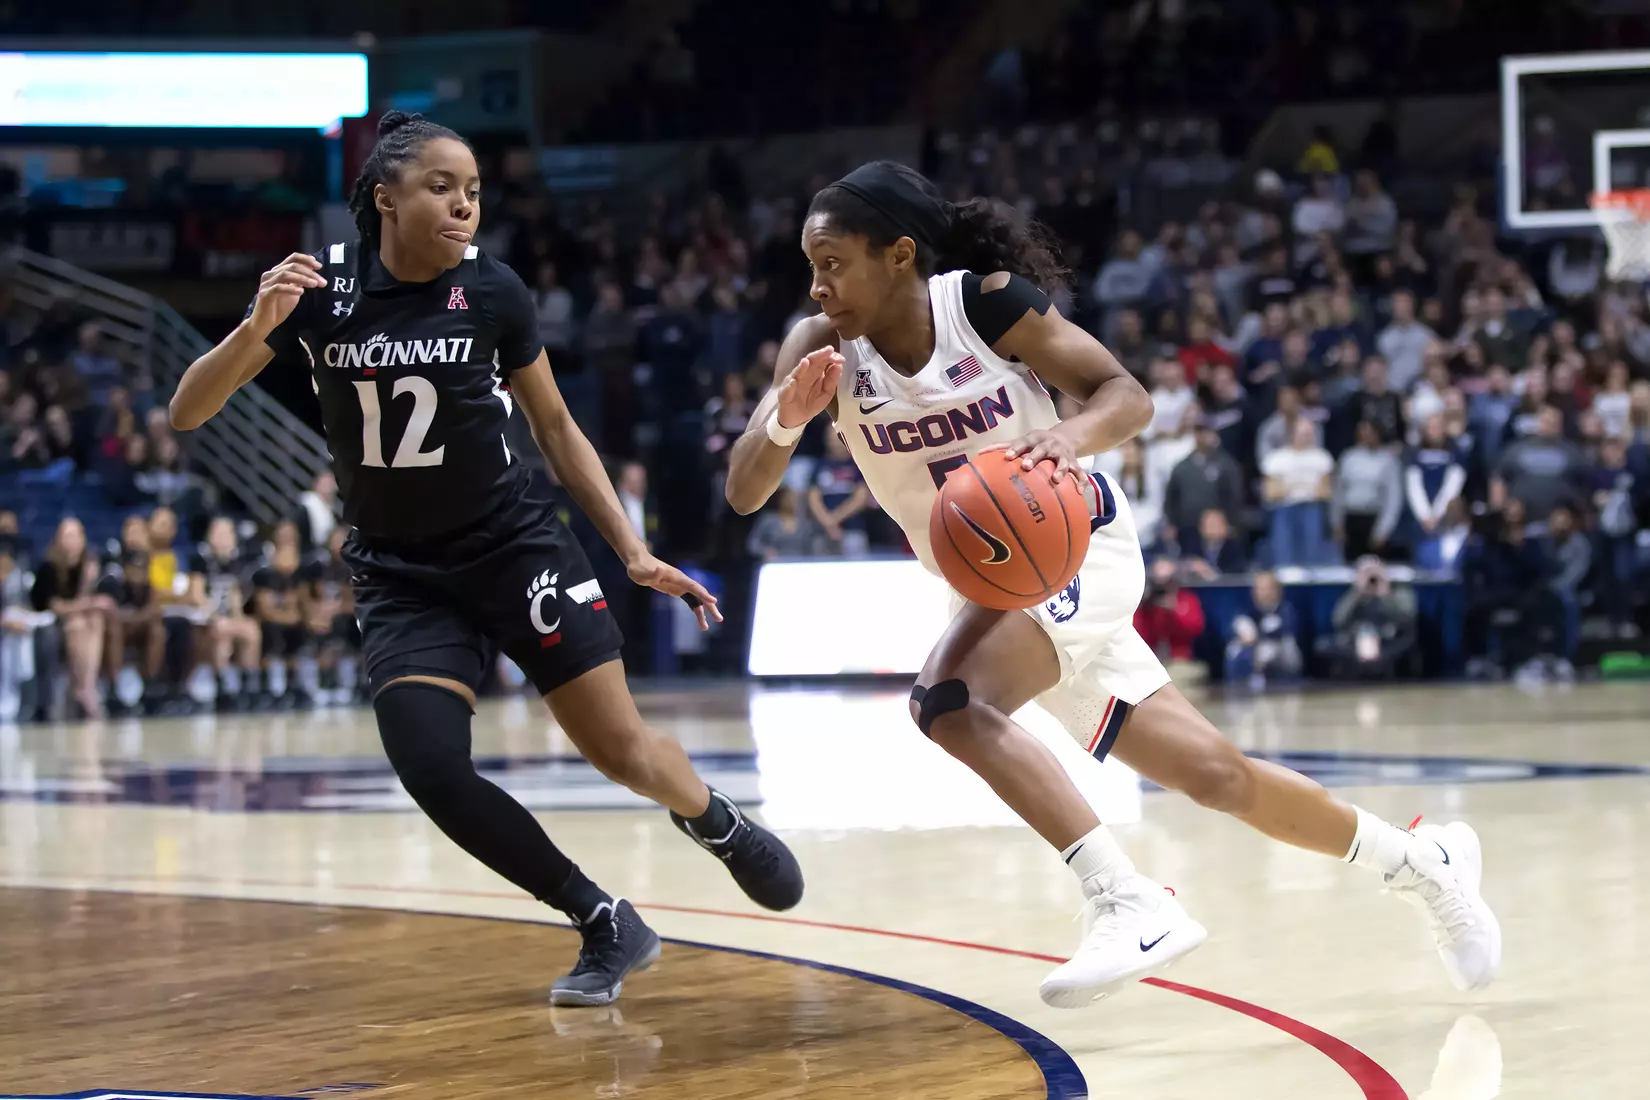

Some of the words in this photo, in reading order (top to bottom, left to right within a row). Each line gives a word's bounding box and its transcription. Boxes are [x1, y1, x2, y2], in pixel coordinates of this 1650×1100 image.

[332, 276, 356, 294] RJ
[324, 333, 474, 368] CINCINNATI
[351, 375, 446, 468] 12
[858, 385, 1015, 455] UCONN
